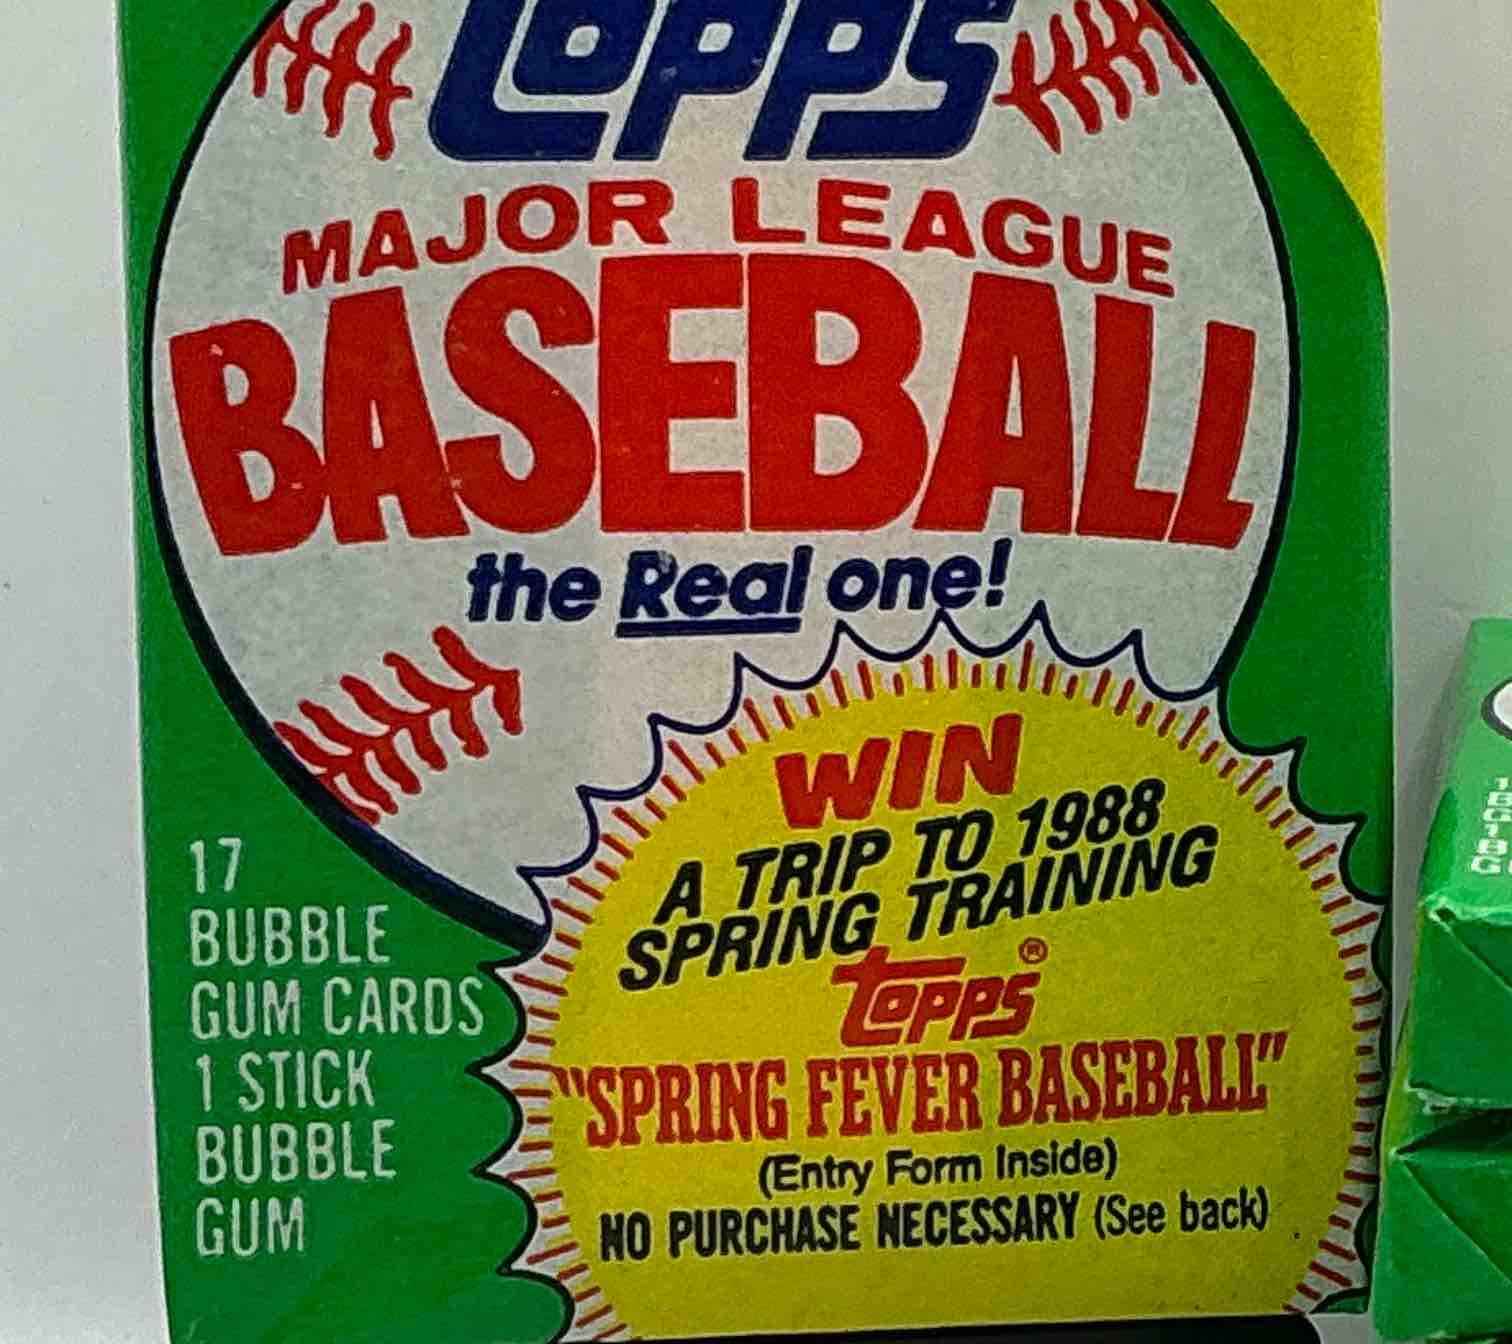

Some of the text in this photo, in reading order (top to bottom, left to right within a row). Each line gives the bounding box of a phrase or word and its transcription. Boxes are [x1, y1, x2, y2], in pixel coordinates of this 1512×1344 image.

[282, 177, 1175, 297] MAJOR LEAGUE
[169, 253, 1256, 557] BASEBALL
[466, 538, 1013, 638] the Real one!
[775, 713, 1023, 829] WIN
[190, 837, 242, 893] 17
[653, 778, 1166, 925] A TRIP TO 1988
[190, 904, 391, 967] BUBBLE
[618, 825, 1219, 991] SPRING TRAINING
[190, 977, 485, 1040] GUM CARDS
[196, 1049, 375, 1112] 1 STICK
[806, 1052, 984, 1138] FEVER
[197, 1118, 397, 1184] BUBBLE
[759, 1137, 1118, 1198] (Entry Form Inside)
[197, 1196, 306, 1256] GUM
[600, 1185, 1269, 1262] NO PURCHASE NECESSARY (See back)
